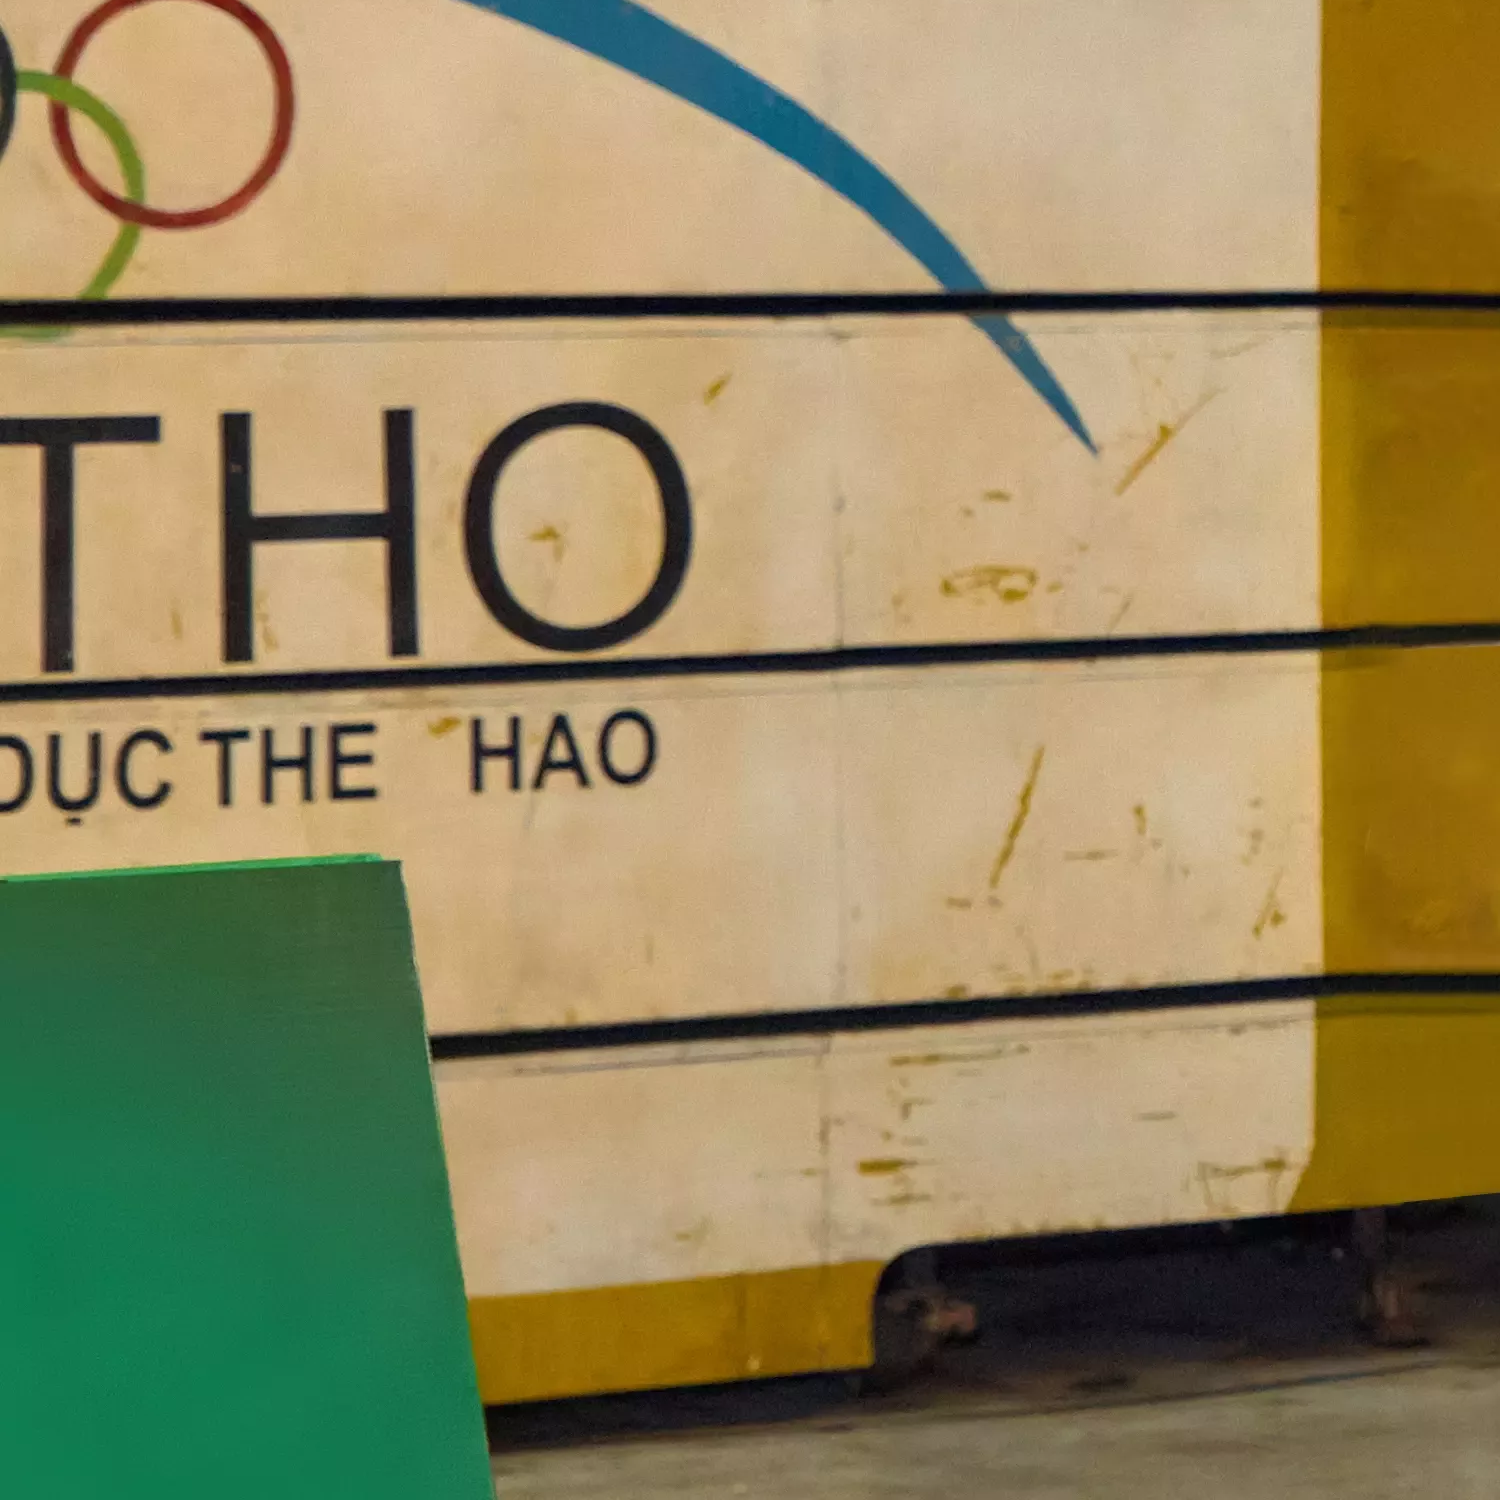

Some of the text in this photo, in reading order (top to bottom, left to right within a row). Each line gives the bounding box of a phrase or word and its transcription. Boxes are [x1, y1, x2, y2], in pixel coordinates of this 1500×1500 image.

[0, 401, 693, 672] THO
[199, 722, 379, 806] THE
[470, 709, 658, 793] HAO
